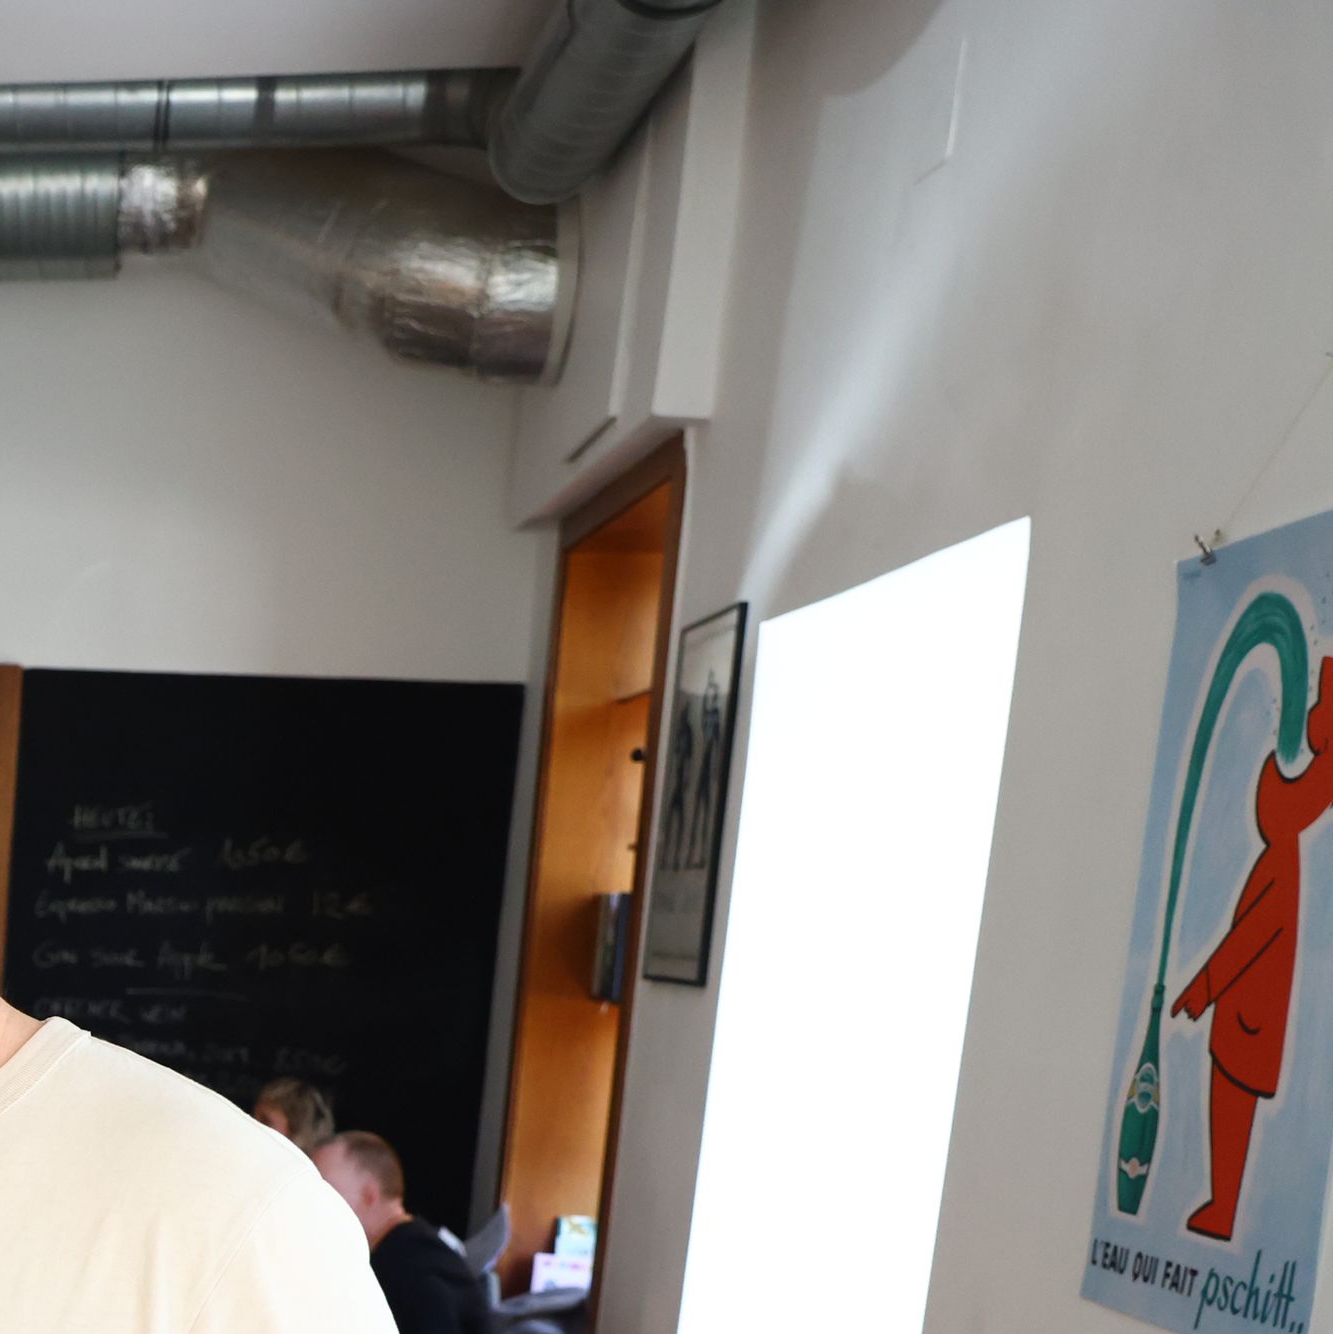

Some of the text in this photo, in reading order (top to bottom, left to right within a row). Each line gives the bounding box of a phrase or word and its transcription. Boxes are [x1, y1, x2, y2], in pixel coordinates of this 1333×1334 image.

[1091, 1238, 1130, 1275] L'EAU
[1132, 1251, 1160, 1286] QUI
[1160, 1259, 1199, 1298] FAIT
